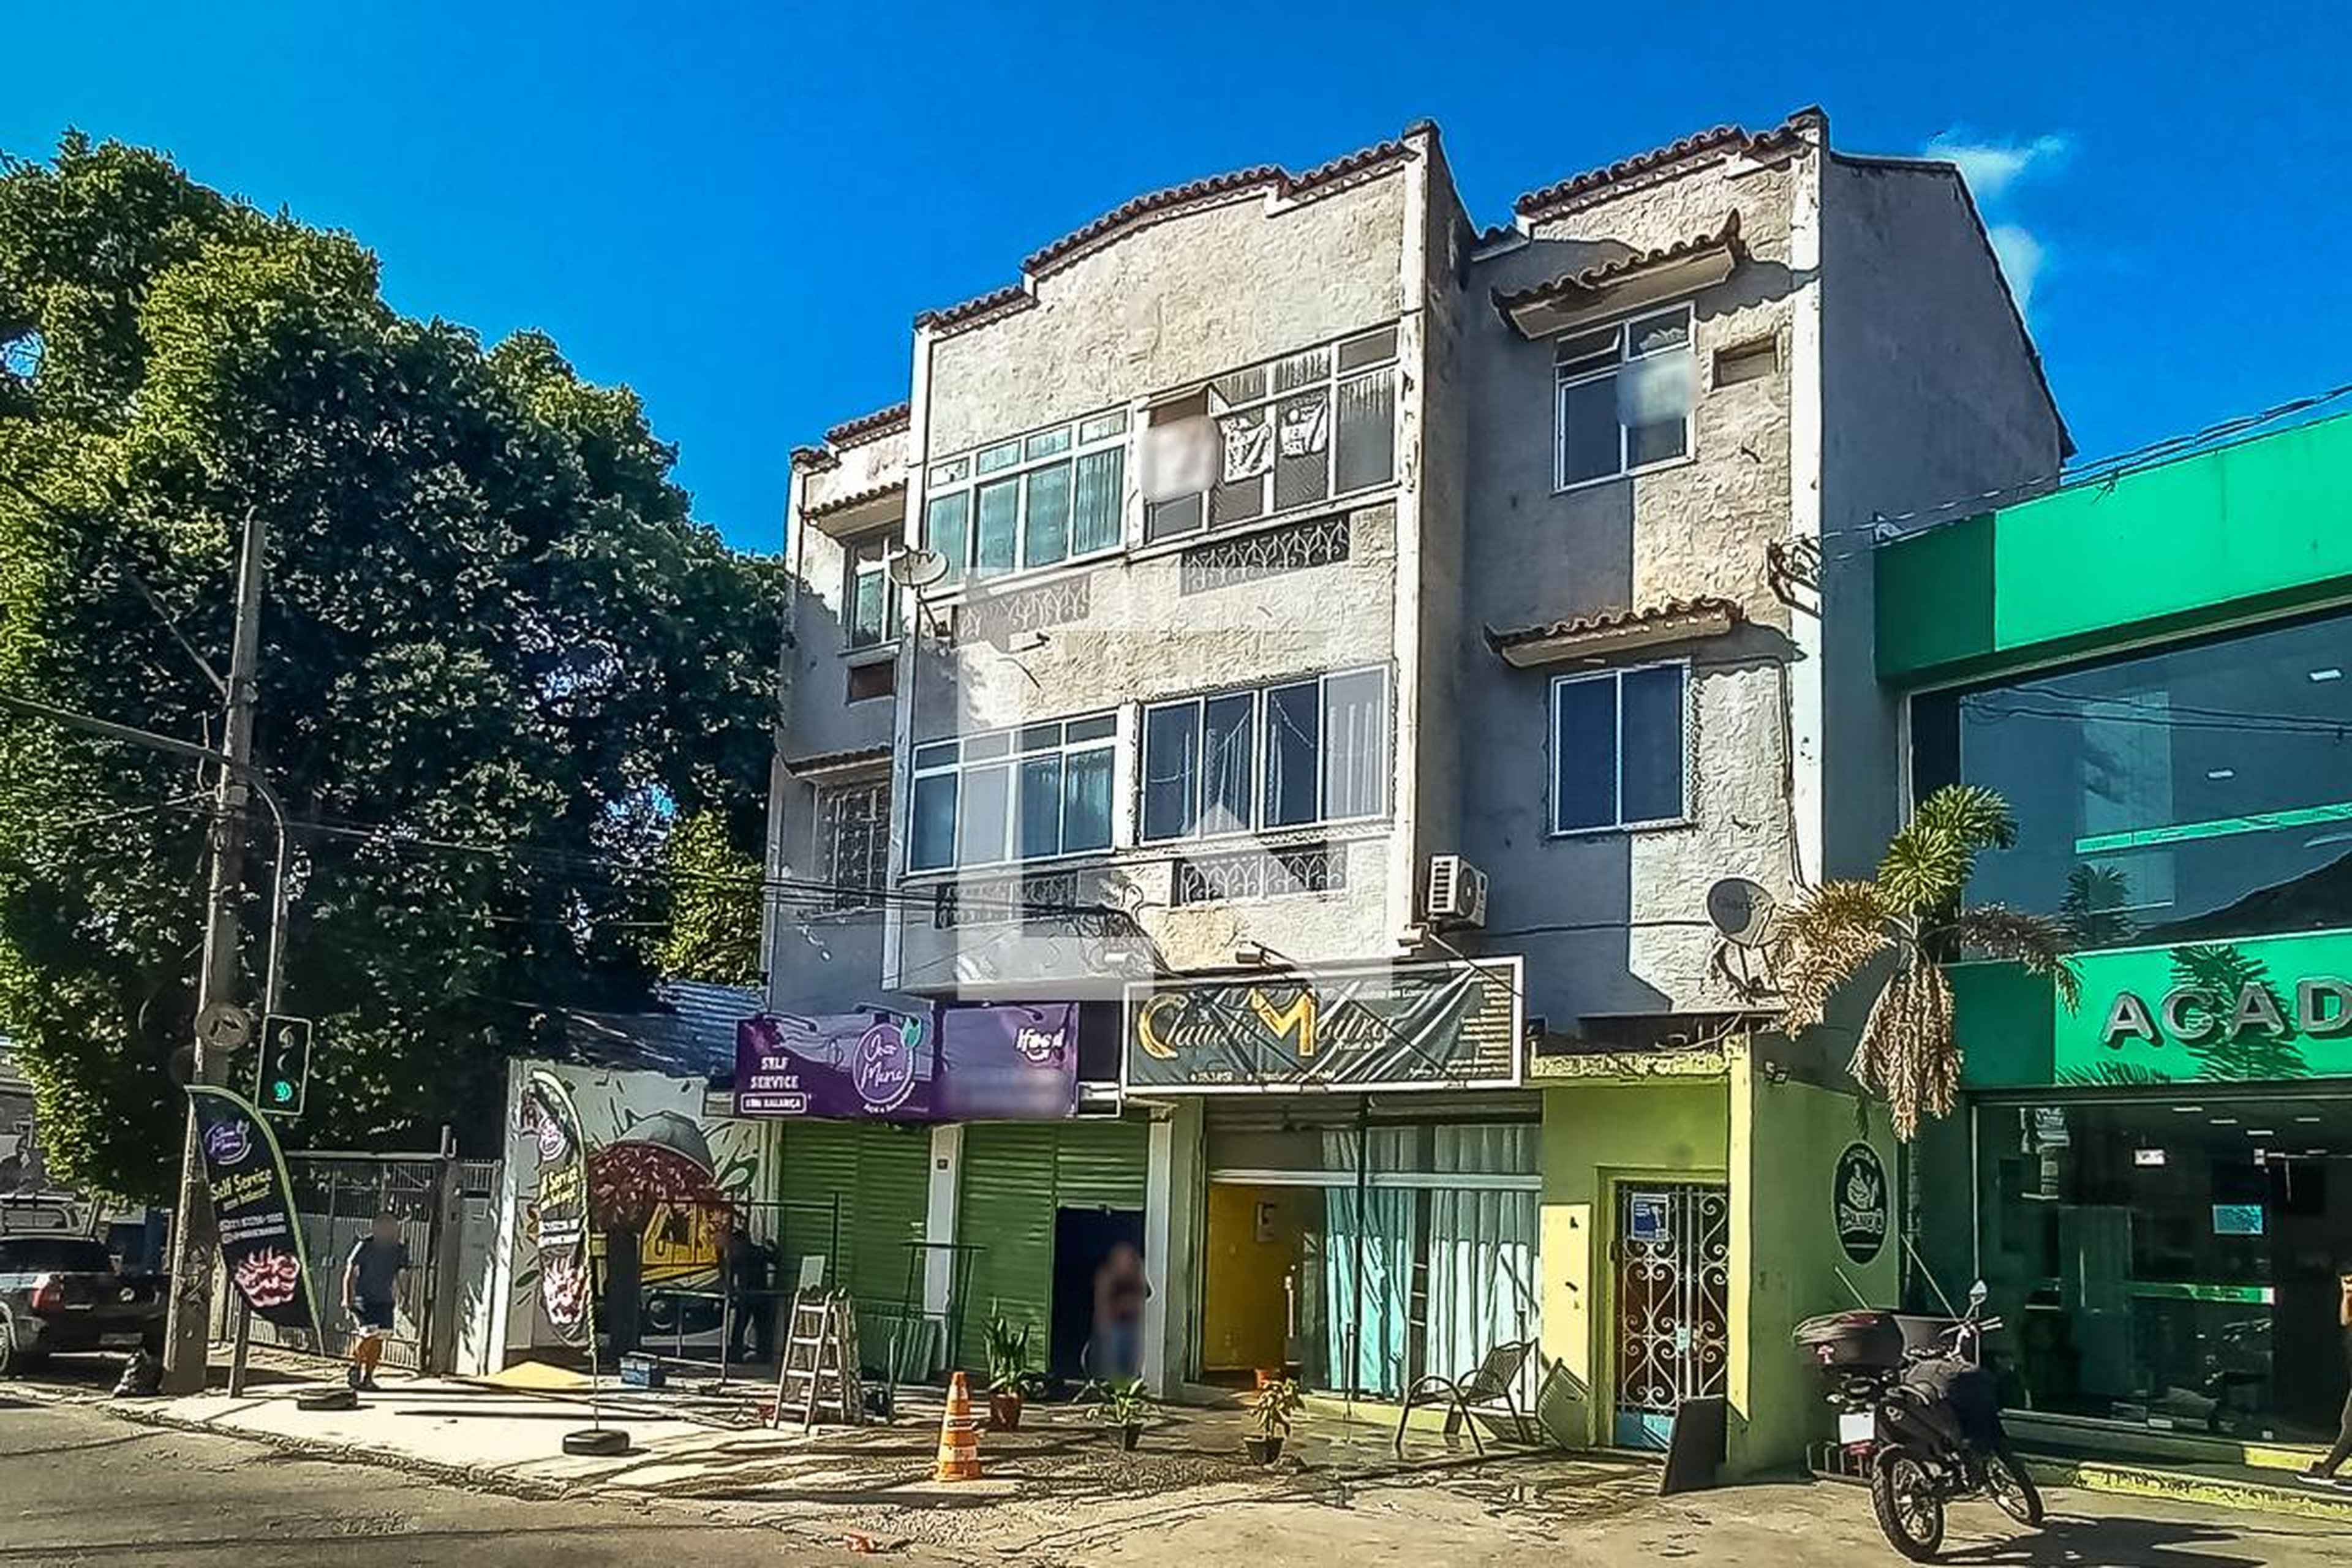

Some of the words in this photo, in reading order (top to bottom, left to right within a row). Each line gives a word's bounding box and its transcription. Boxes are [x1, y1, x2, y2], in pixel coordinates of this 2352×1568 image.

[2103, 976, 2352, 1043] ACAD
[761, 1057, 790, 1070] SELF
[750, 1076, 799, 1089] SERVICE
[209, 1177, 232, 1202] Self
[233, 1167, 272, 1192] Service
